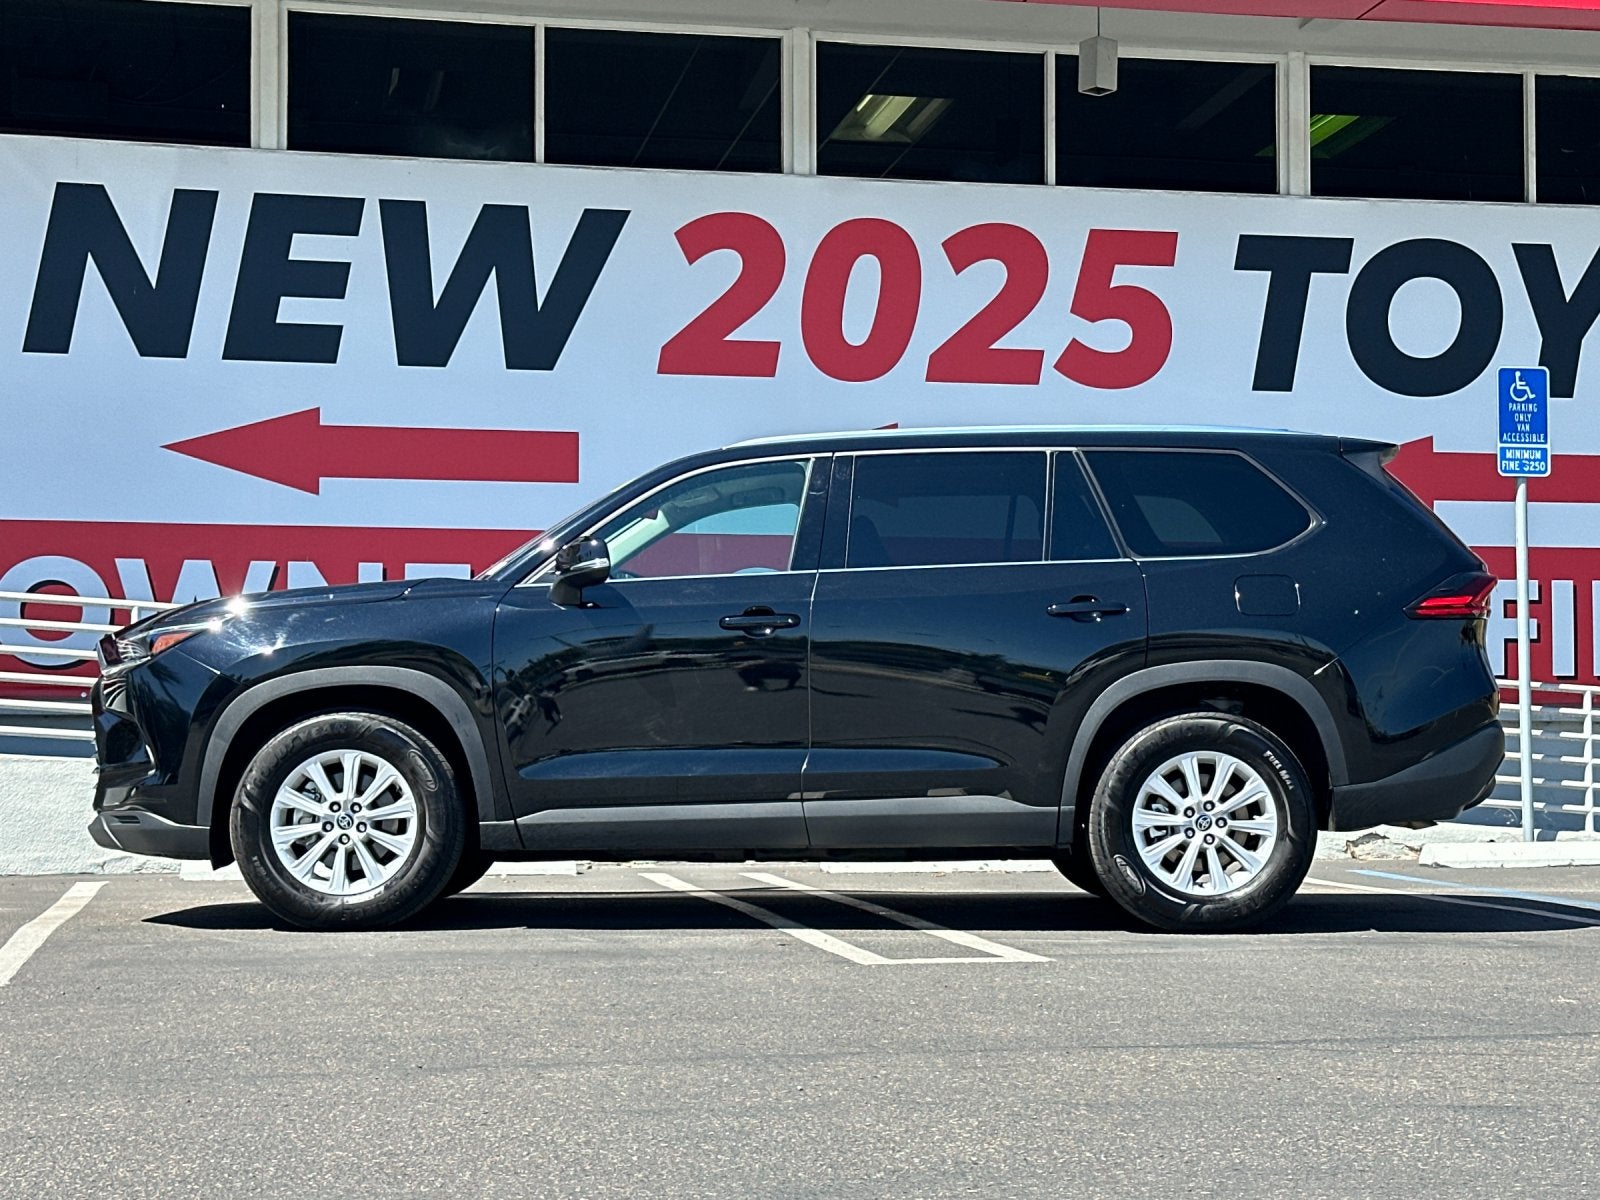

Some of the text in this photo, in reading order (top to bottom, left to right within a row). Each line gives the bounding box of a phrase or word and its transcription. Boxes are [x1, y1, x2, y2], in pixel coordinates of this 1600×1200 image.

[22, 181, 631, 371] NEW
[656, 211, 1179, 390] 2025
[1508, 402, 1538, 412] PARKING
[1514, 413, 1532, 422] ONLY
[1516, 423, 1530, 432] VAN
[1502, 432, 1545, 443] ACCESSIBLE
[1505, 449, 1541, 460] MINIMUM
[1501, 460, 1520, 471] FINE
[1486, 579, 1600, 677] FI
